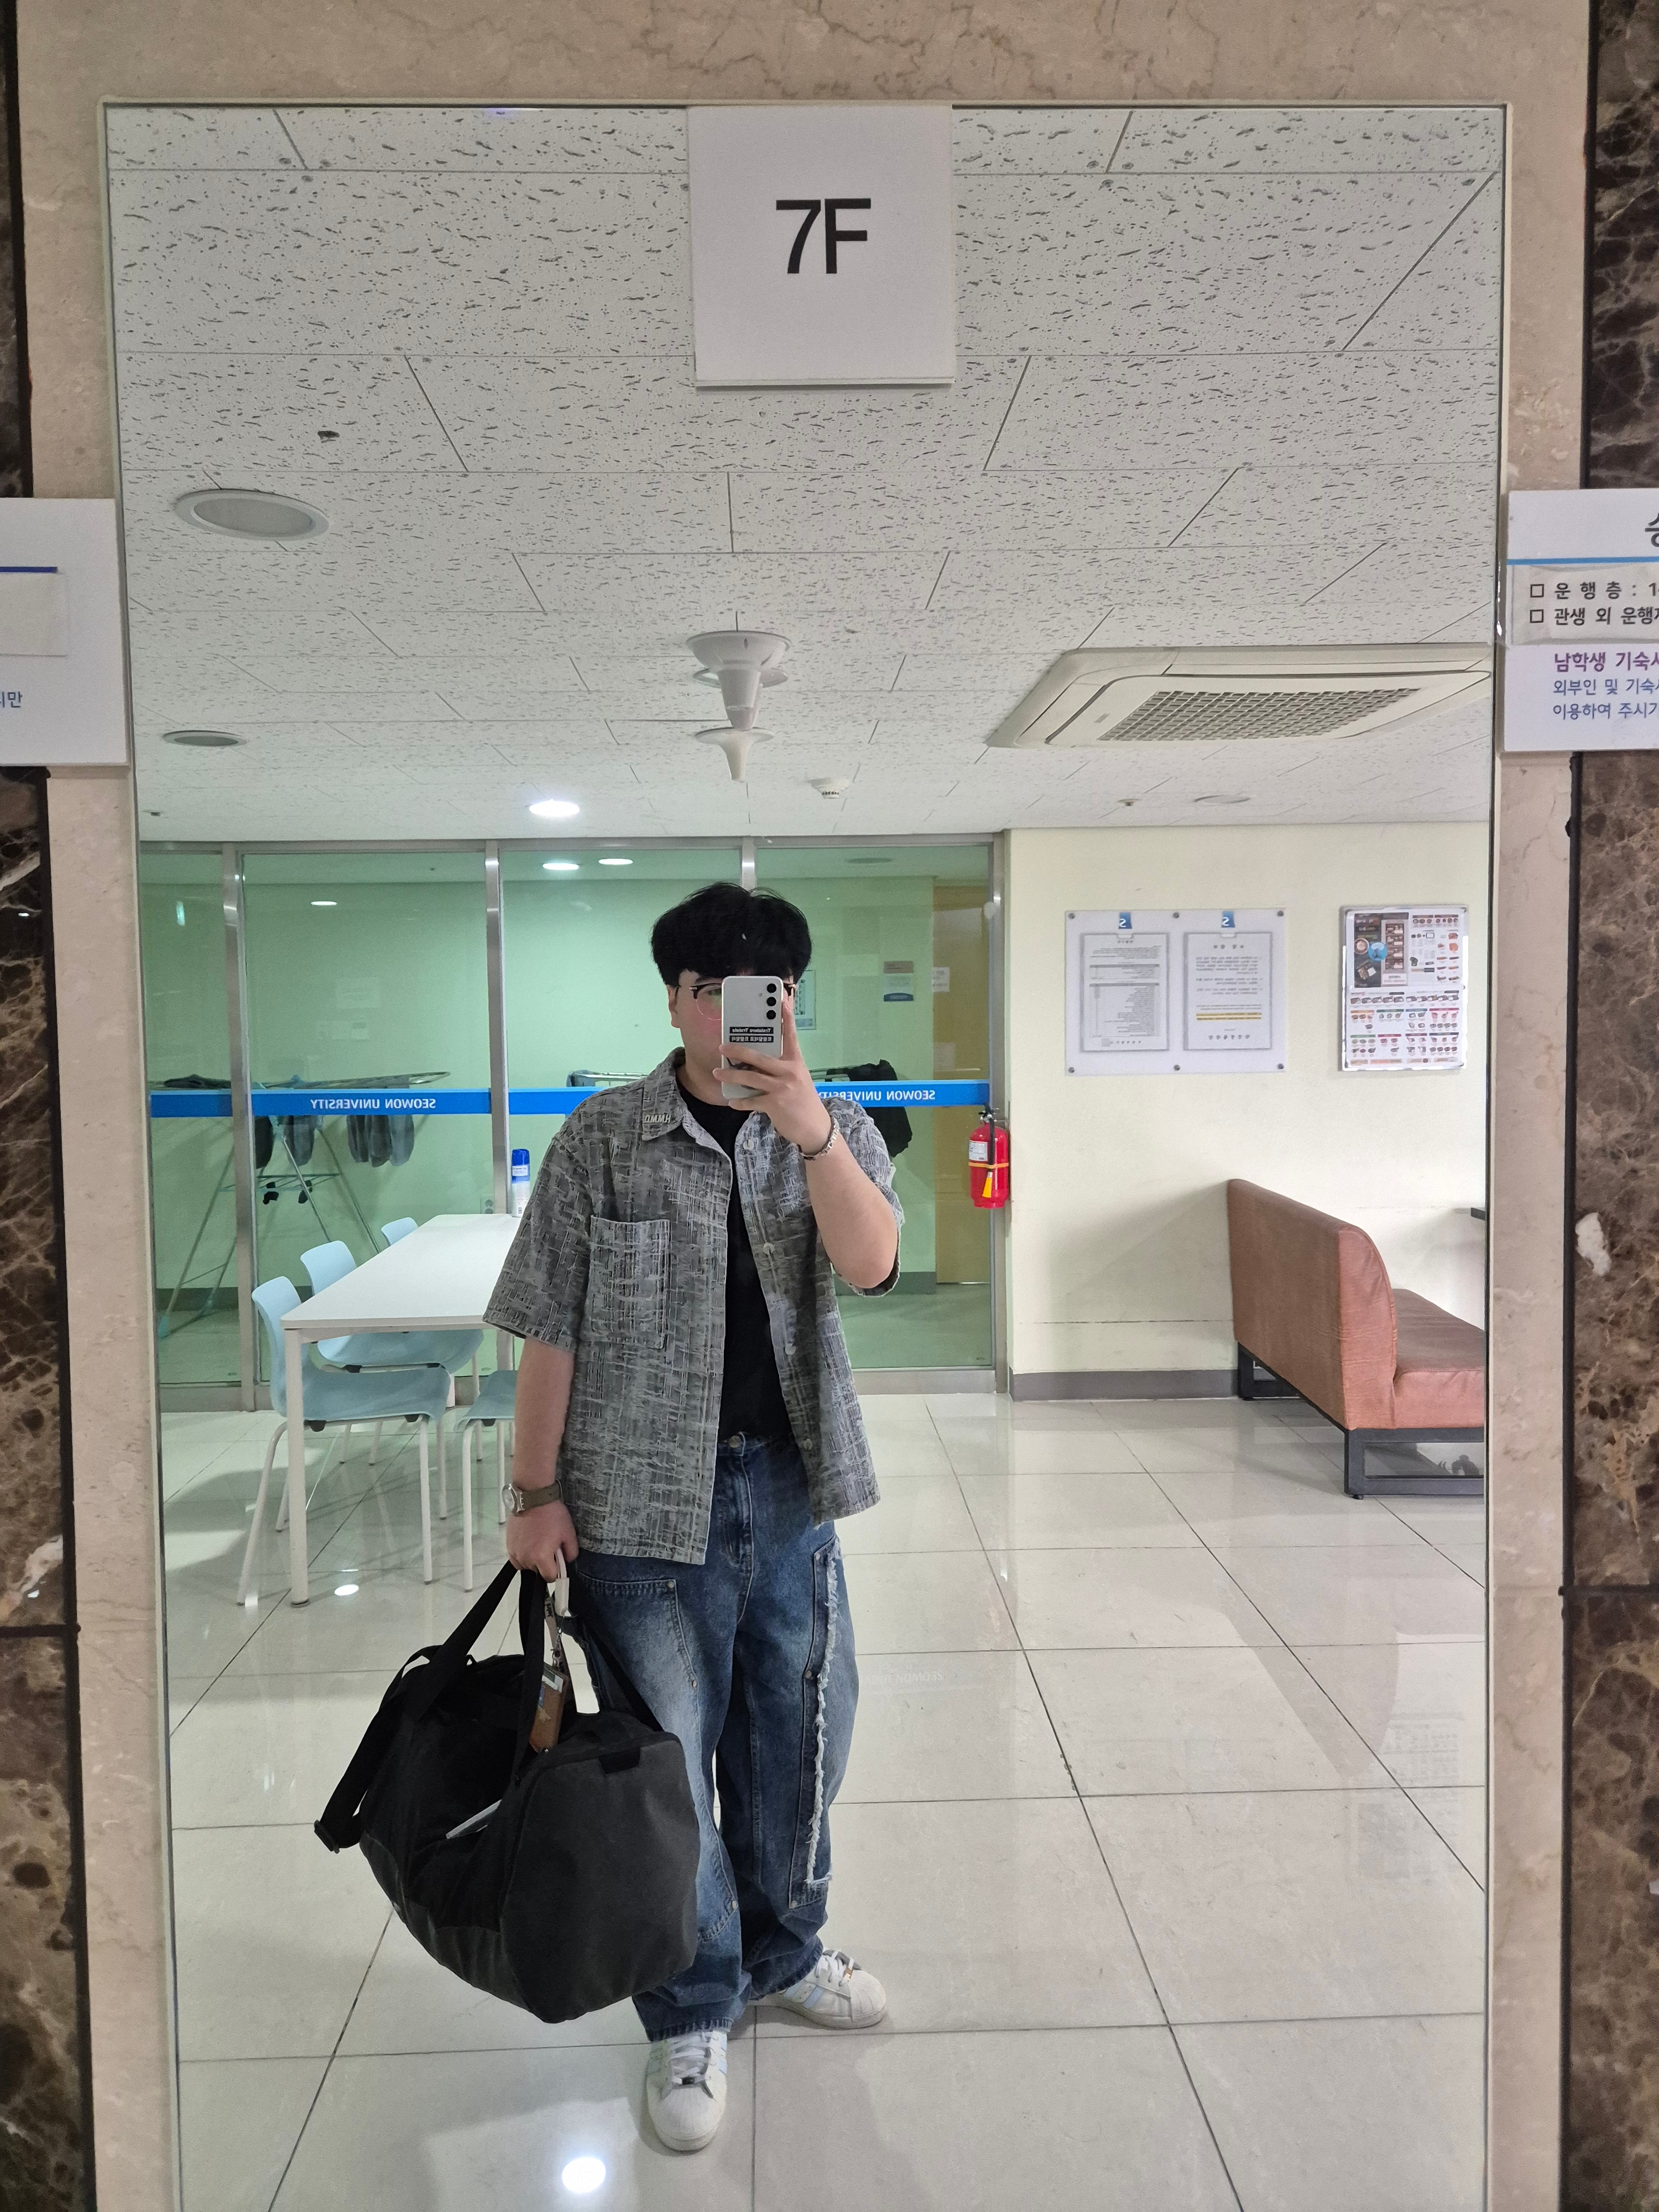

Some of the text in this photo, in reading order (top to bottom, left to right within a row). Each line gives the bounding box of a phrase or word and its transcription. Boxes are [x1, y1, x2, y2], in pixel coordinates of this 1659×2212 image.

[776, 198, 872, 274] 7F
[1648, 582, 1659, 597] 1
[1554, 607, 1585, 626] 관생
[1595, 606, 1612, 625] 외
[1554, 651, 1606, 672] 남학생
[1553, 677, 1659, 696] 외부인 및 기숙
[1553, 702, 1611, 720] 이용하여
